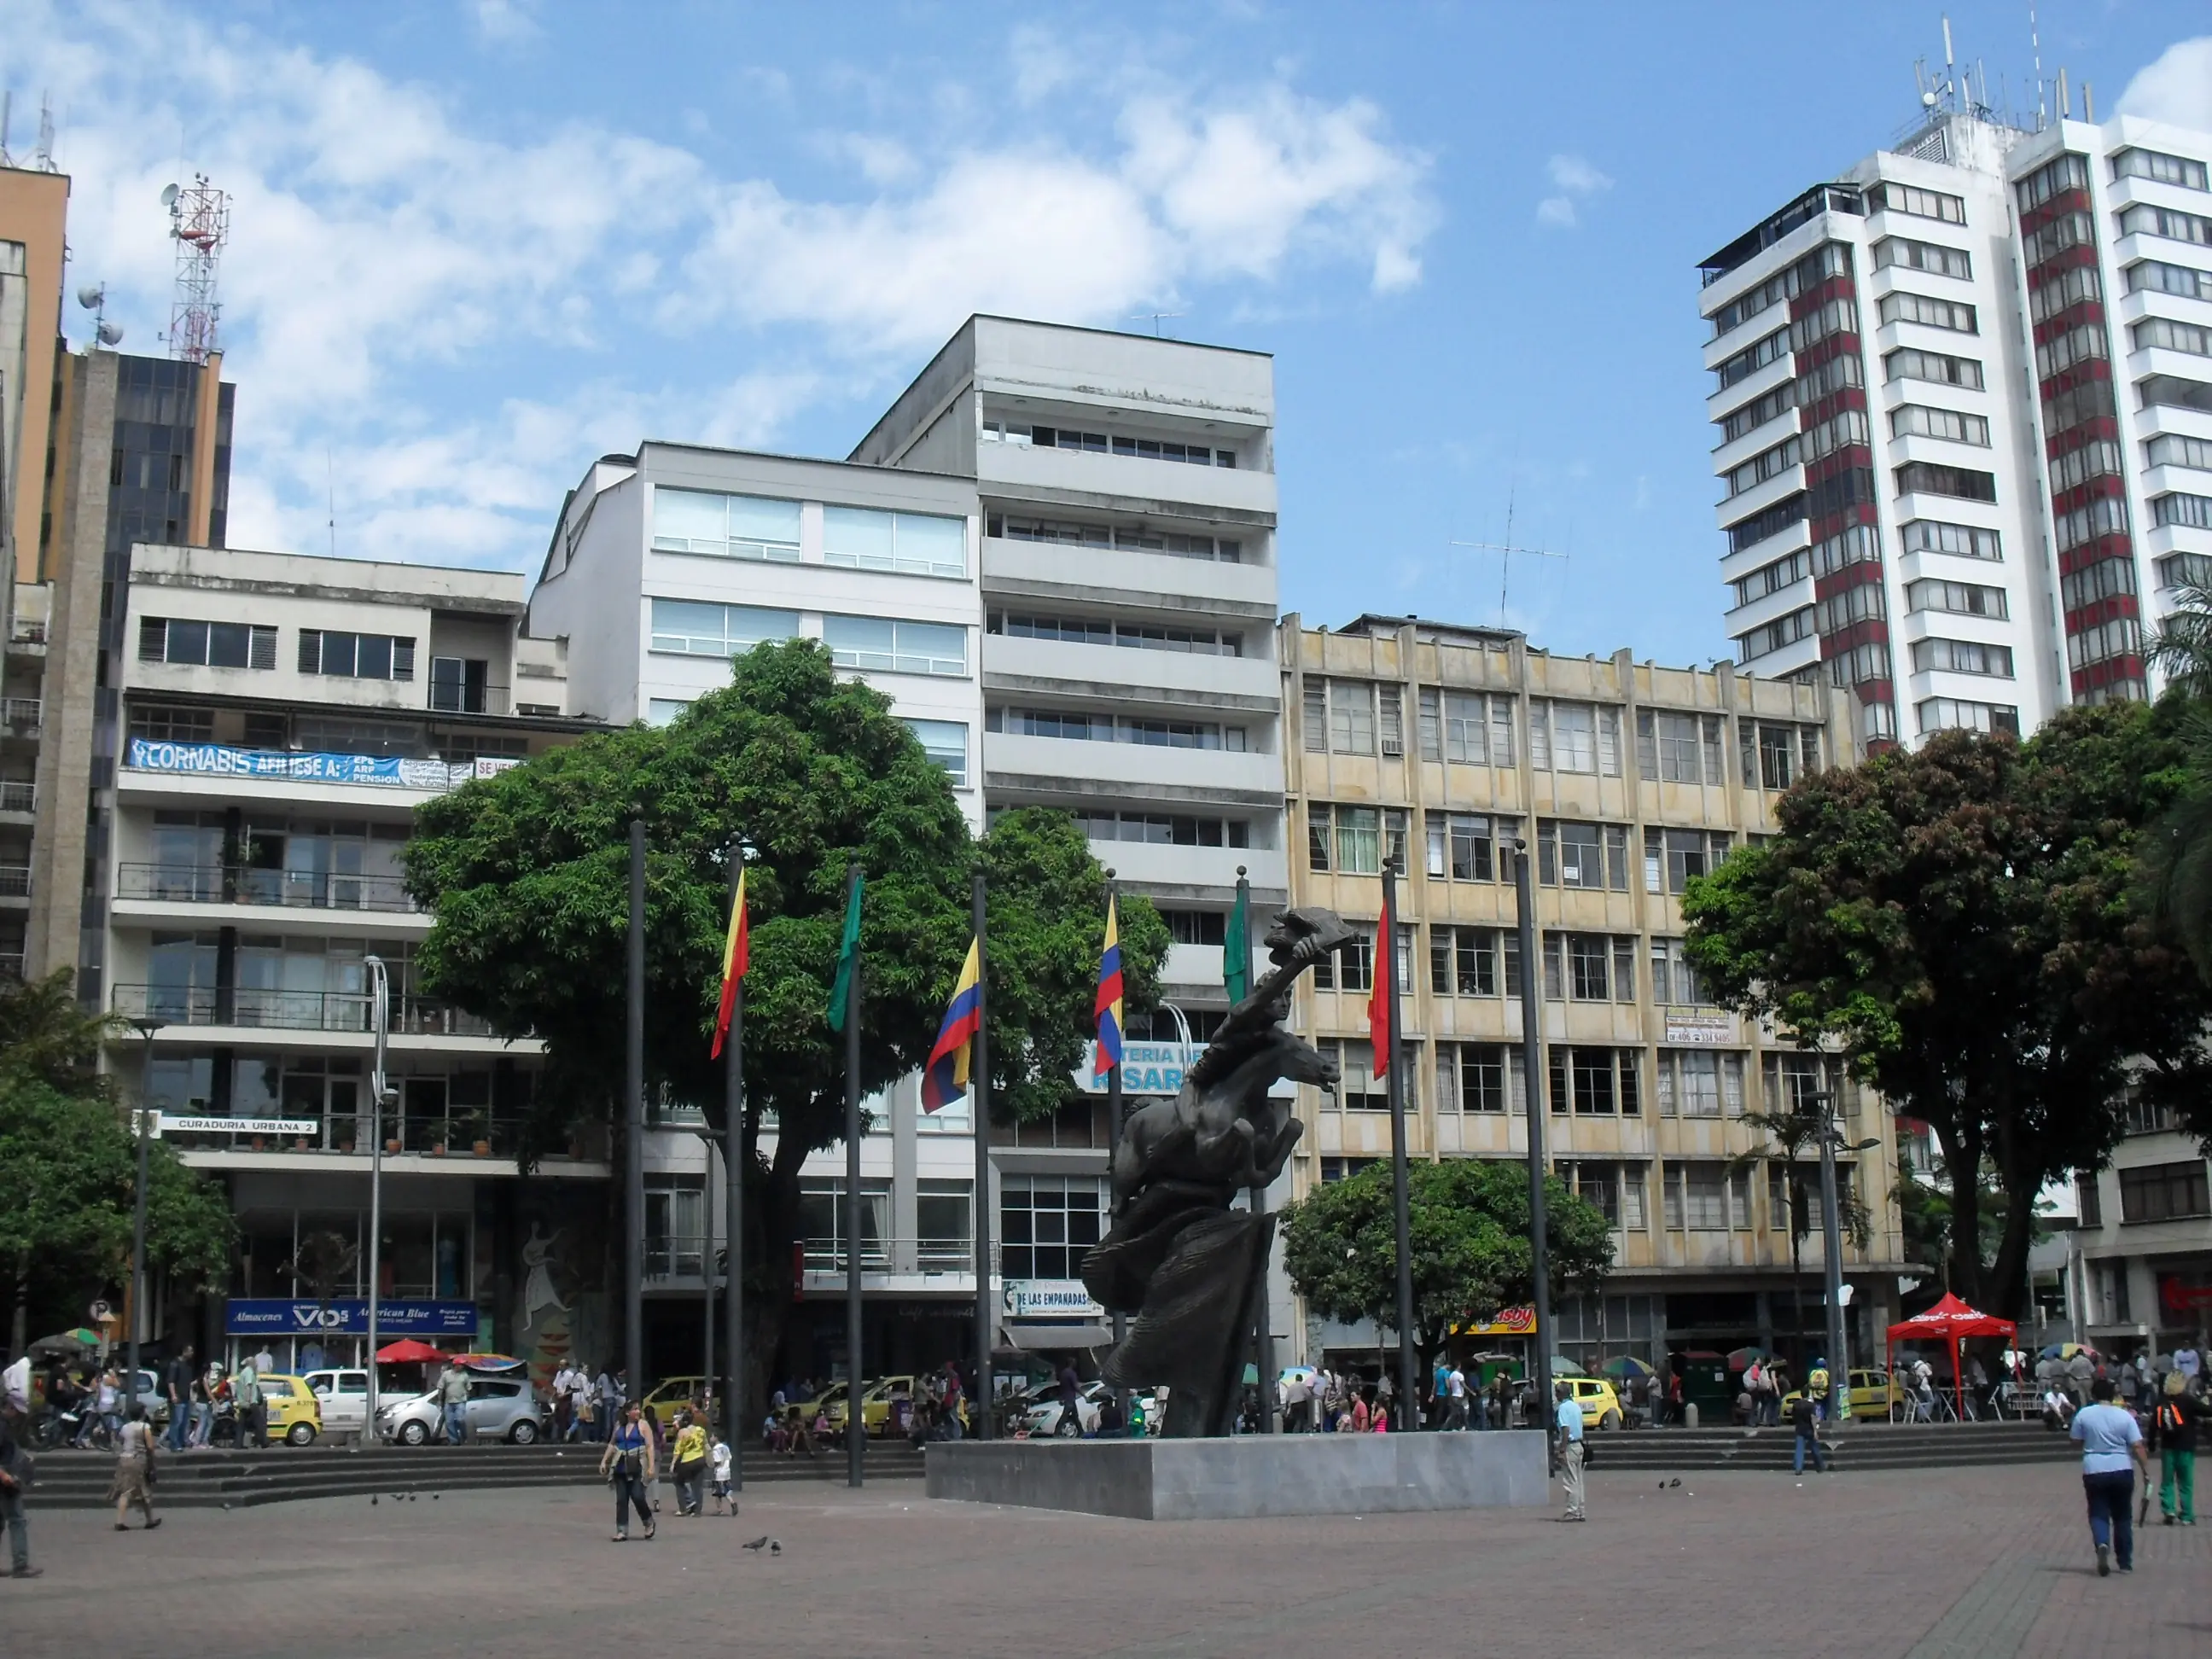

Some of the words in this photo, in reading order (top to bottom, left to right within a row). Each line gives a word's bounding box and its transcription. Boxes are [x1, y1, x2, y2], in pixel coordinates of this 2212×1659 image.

[147, 744, 250, 773] CORNABIS
[325, 759, 341, 777] A:
[353, 765, 375, 774] ARP
[479, 762, 492, 774] SE
[352, 773, 400, 784] PENSION
[178, 1120, 247, 1131] CURADURIA
[252, 1121, 300, 1132] URBANA
[306, 1123, 312, 1132] 2
[1016, 1293, 1027, 1306] DE
[1028, 1293, 1042, 1307] LAS
[1044, 1292, 1086, 1306] EMPANADAS
[234, 1311, 282, 1322] Almacenes
[406, 1308, 430, 1318] Blue
